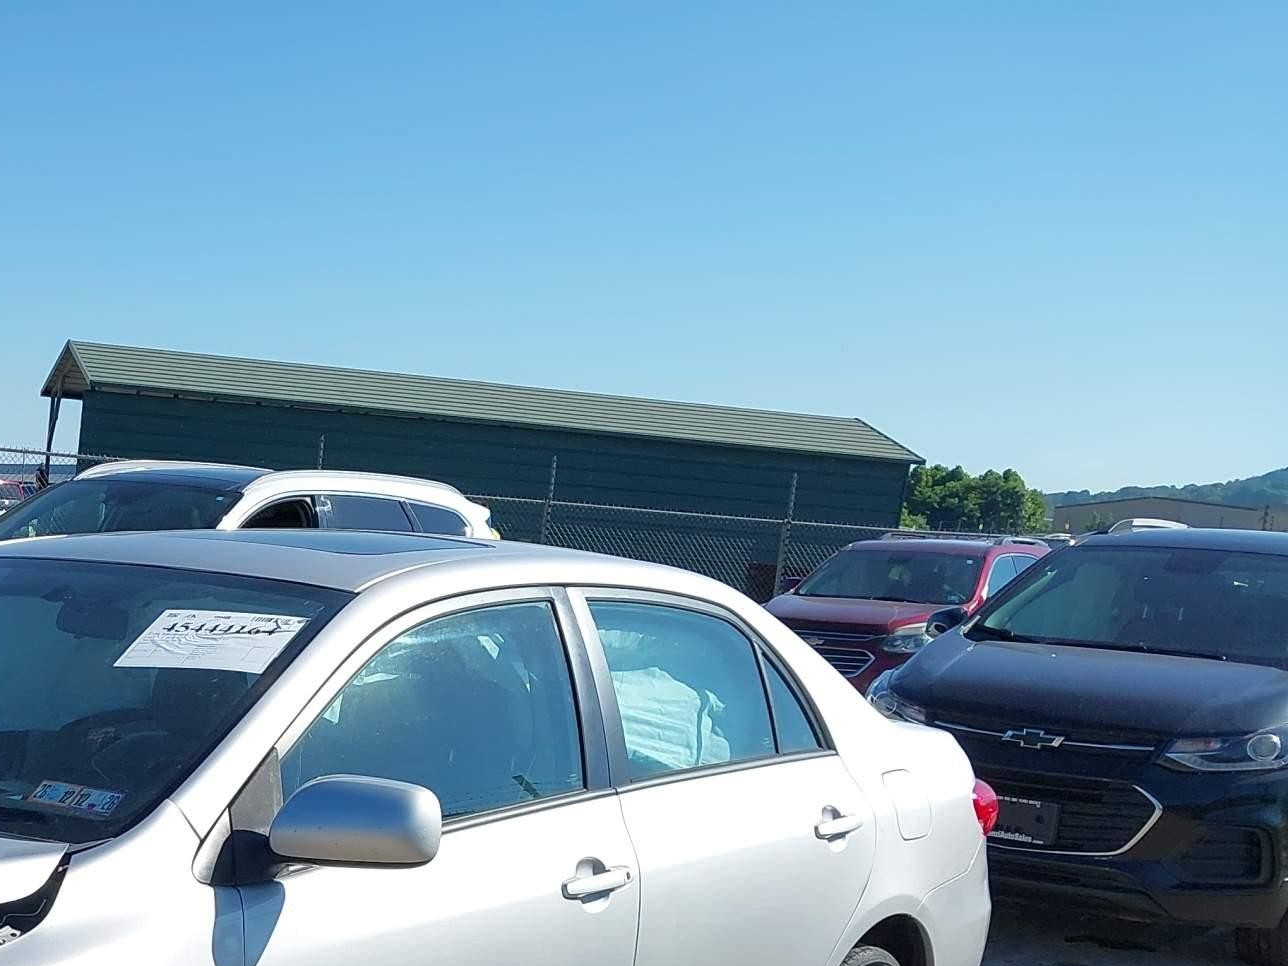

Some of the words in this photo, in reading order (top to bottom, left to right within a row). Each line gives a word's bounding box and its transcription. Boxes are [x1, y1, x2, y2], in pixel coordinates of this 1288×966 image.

[163, 619, 280, 636] 45444164
[58, 790, 75, 804] 12
[74, 793, 91, 807] 12
